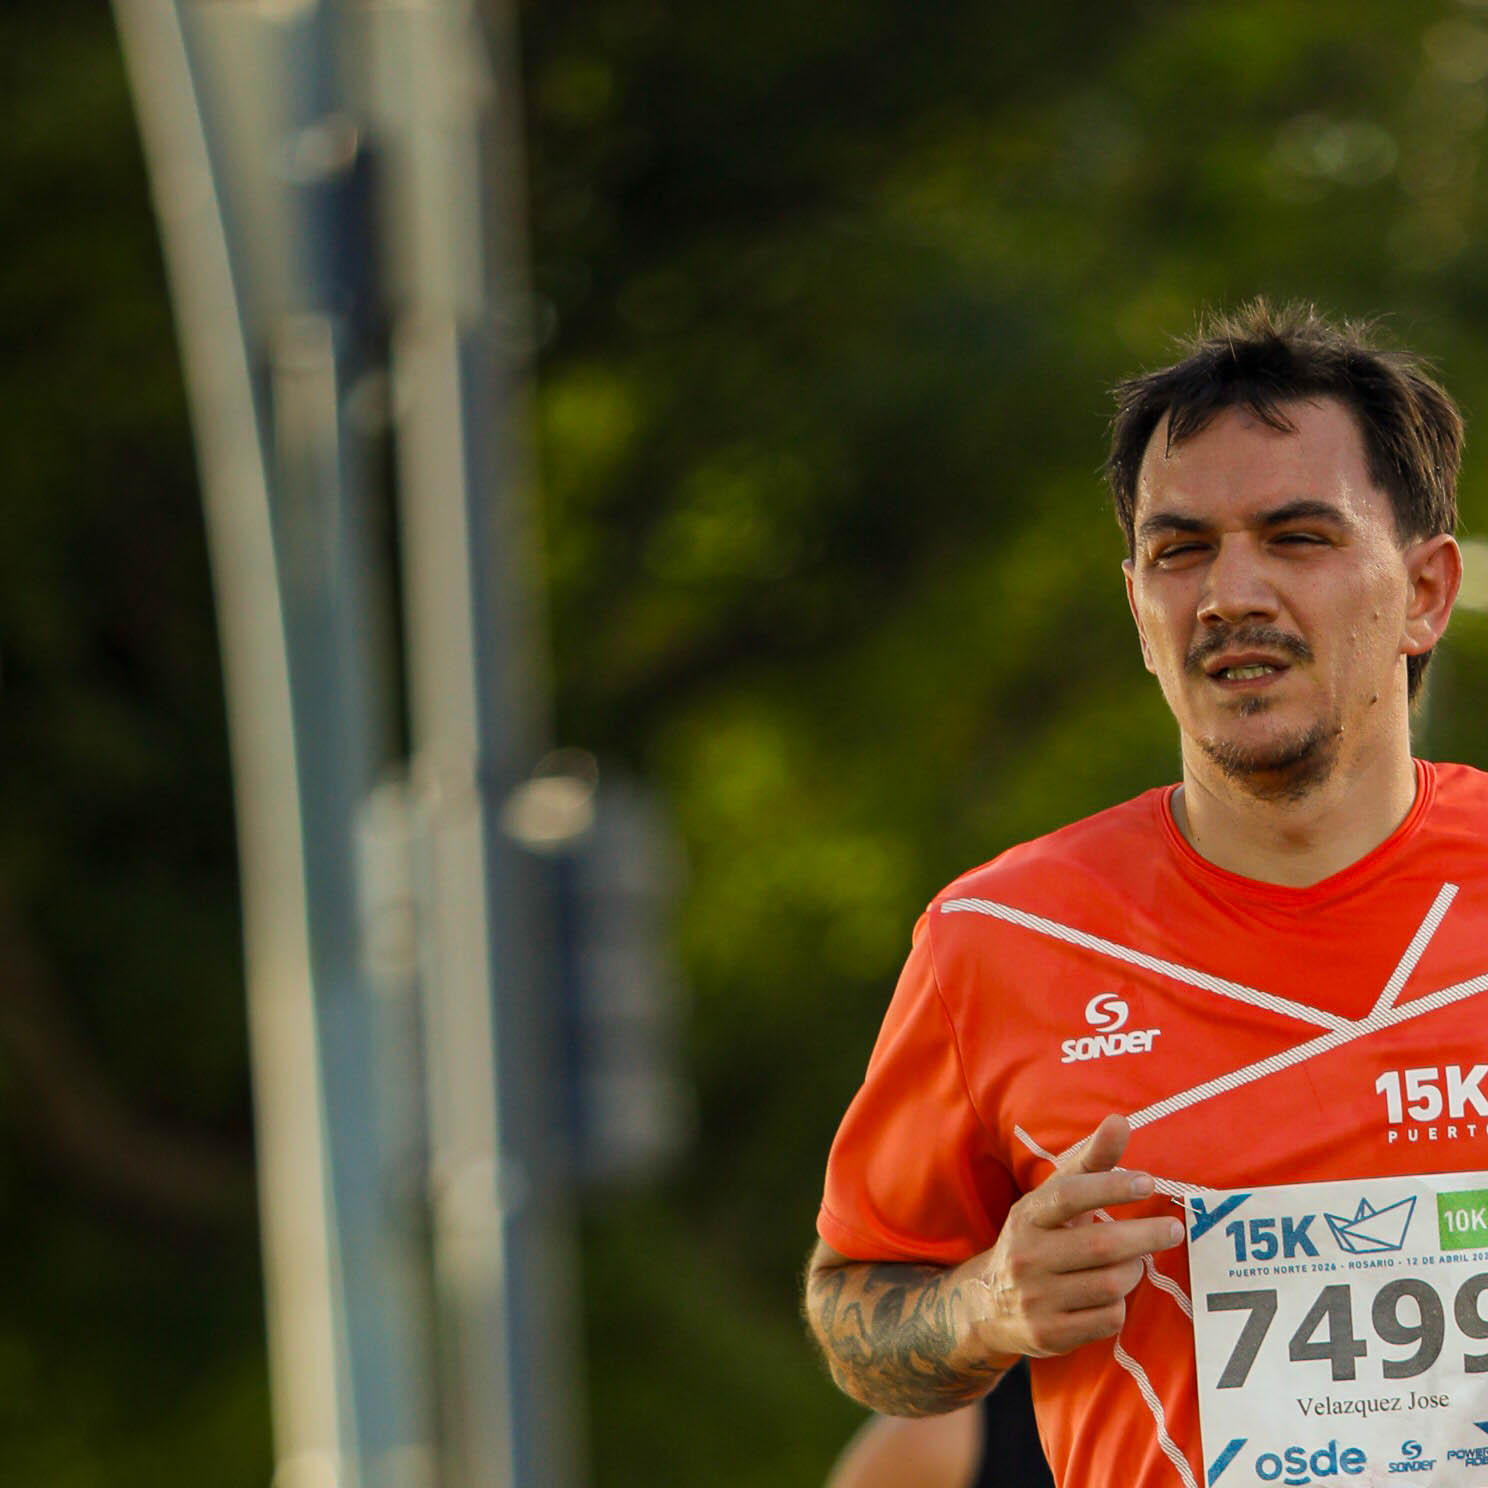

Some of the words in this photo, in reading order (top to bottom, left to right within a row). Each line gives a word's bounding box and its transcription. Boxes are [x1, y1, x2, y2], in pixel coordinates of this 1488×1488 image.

[1443, 1207, 1488, 1233] 10K
[1225, 1214, 1320, 1263] 15K
[1228, 1267, 1270, 1278] PUERTO
[1273, 1263, 1308, 1274] NORTE
[1311, 1263, 1337, 1272] 2026
[1348, 1258, 1395, 1269] ROSARIO
[1406, 1257, 1418, 1266] 12
[1422, 1255, 1435, 1265] DE
[1439, 1254, 1469, 1265] ABRIL
[1296, 1394, 1402, 1418] Velazquez
[1407, 1391, 1450, 1411] Jose
[1255, 1439, 1368, 1482] osde
